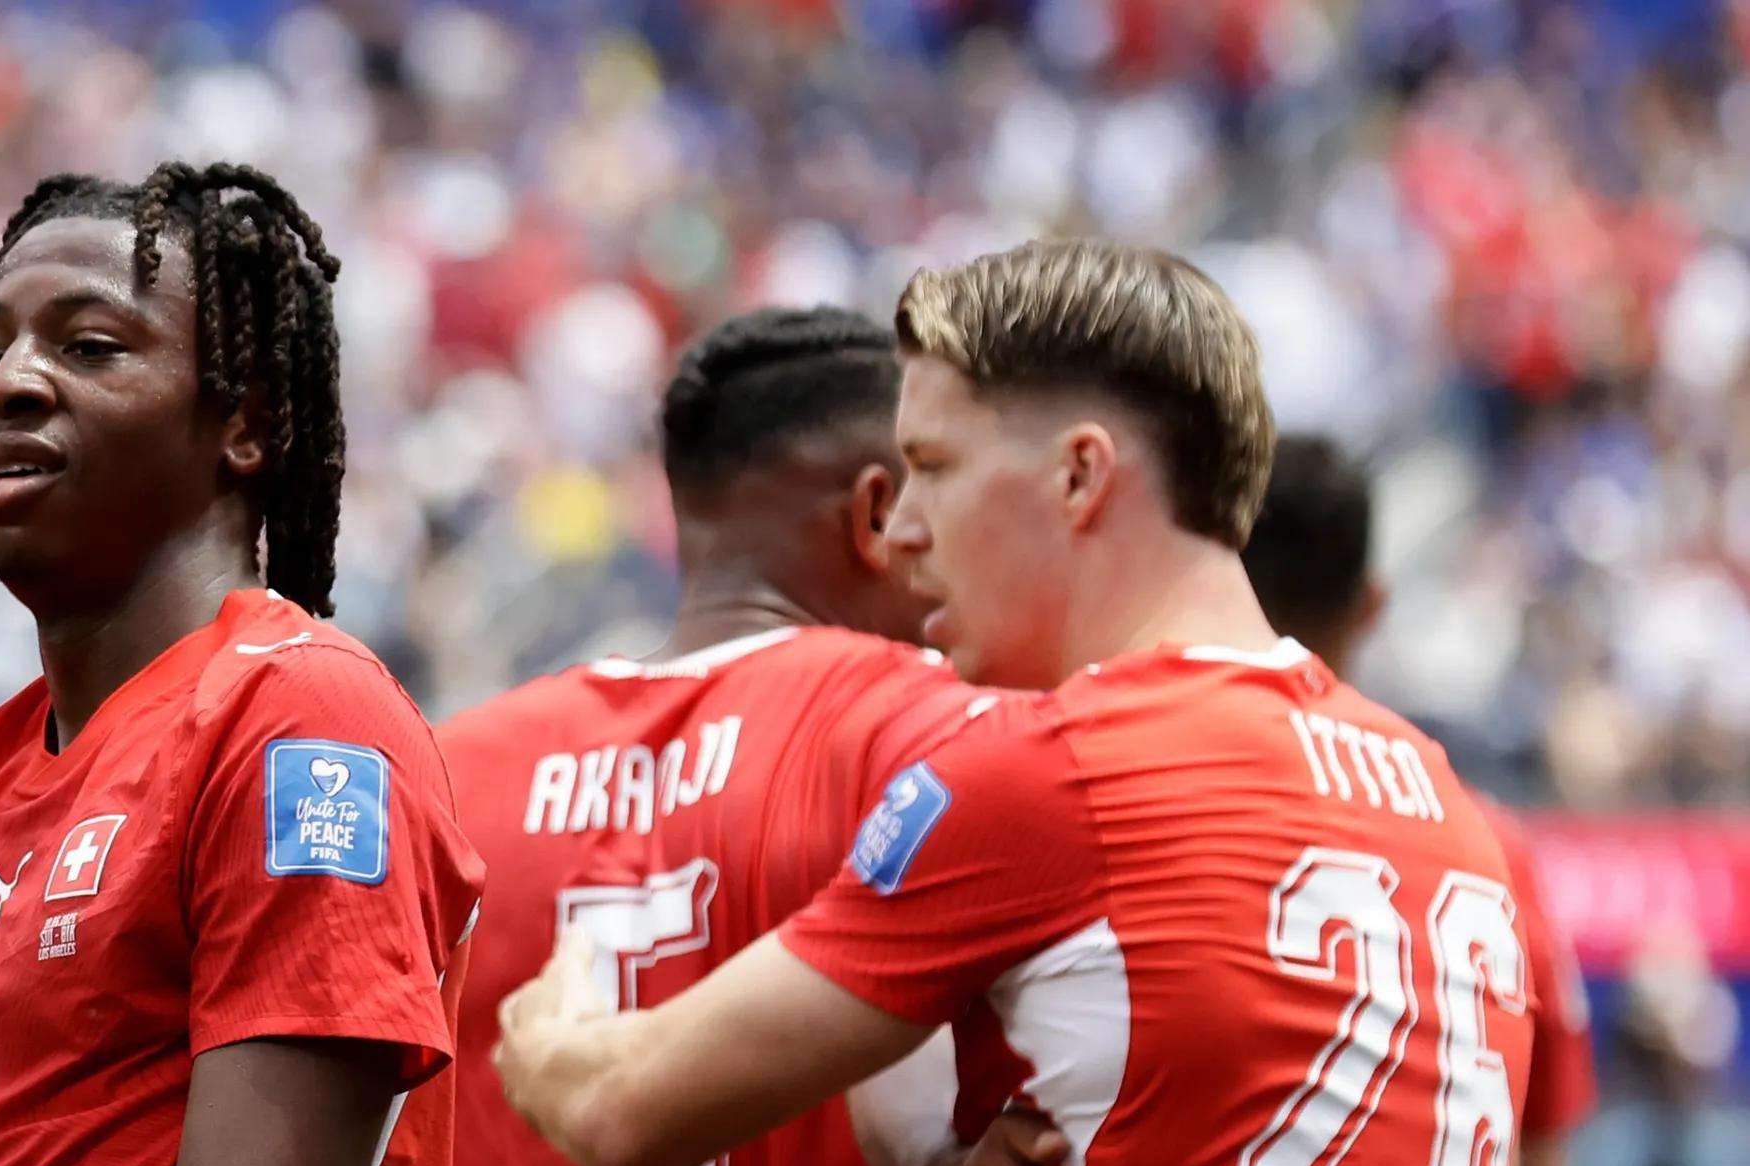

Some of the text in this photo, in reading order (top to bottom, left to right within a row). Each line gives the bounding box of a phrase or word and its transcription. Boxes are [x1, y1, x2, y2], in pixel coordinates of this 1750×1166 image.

[523, 715, 742, 835] AKANJI
[1289, 709, 1445, 823] ITTEN
[296, 797, 360, 823] Unite For
[299, 821, 355, 849] PEACE
[310, 846, 342, 862] FIFA
